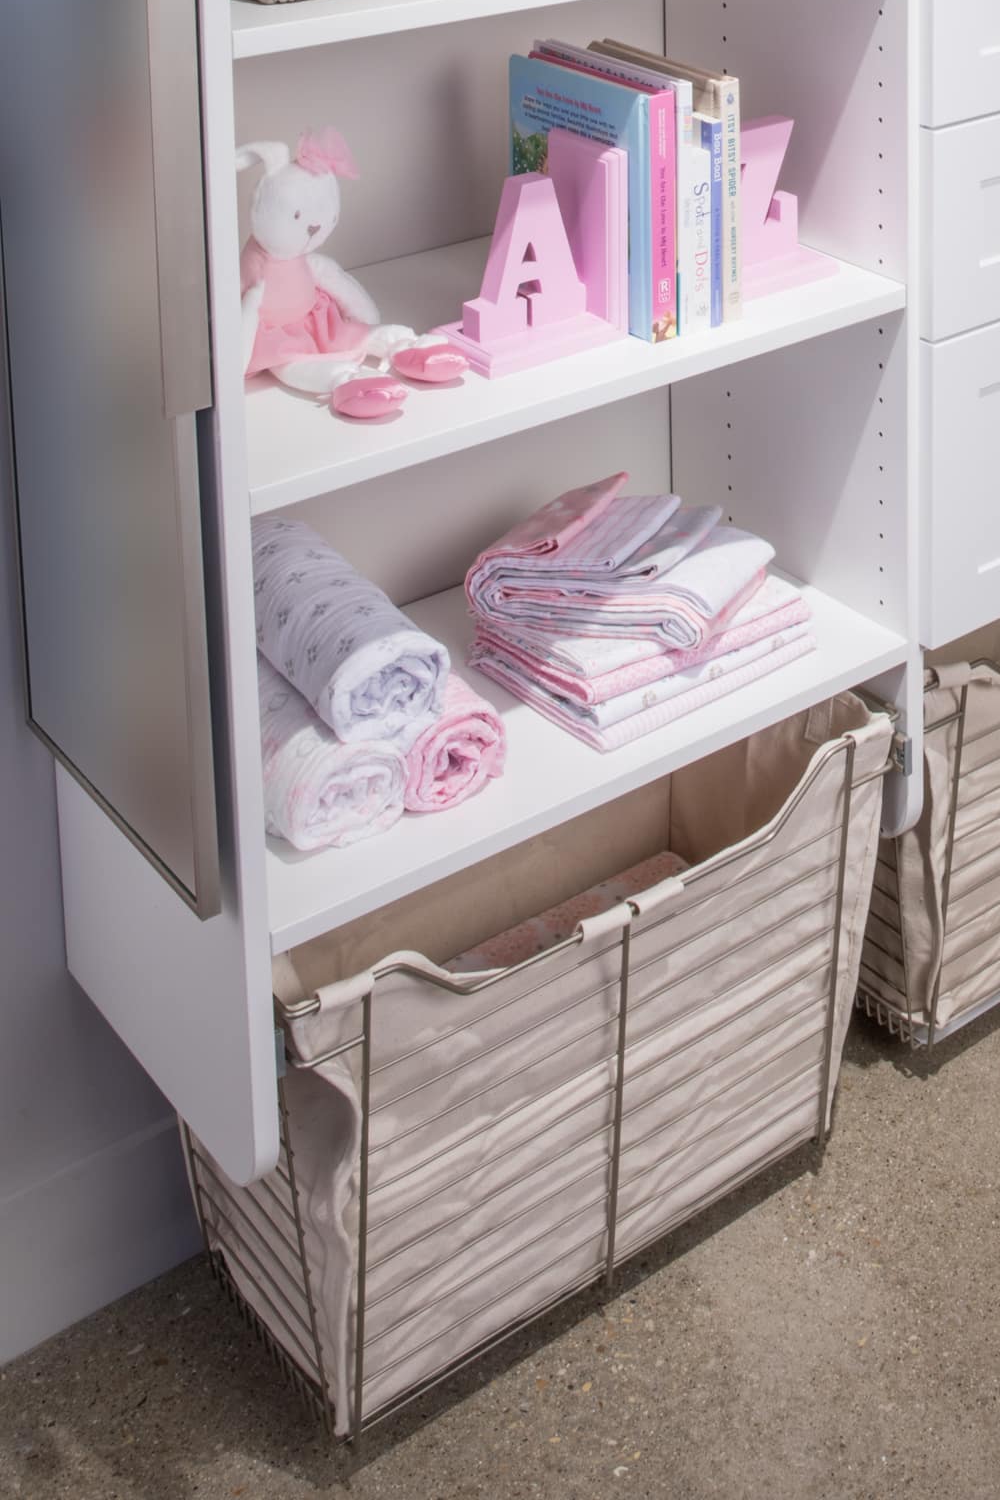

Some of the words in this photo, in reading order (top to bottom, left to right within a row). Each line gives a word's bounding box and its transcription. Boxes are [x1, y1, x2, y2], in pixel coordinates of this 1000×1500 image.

[728, 114, 736, 133] ITSY
[714, 132, 722, 155] Baa
[728, 138, 737, 162] BITSY
[728, 167, 737, 197] SPIDER
[693, 181, 711, 226] Spots
[695, 251, 709, 292] Dots
